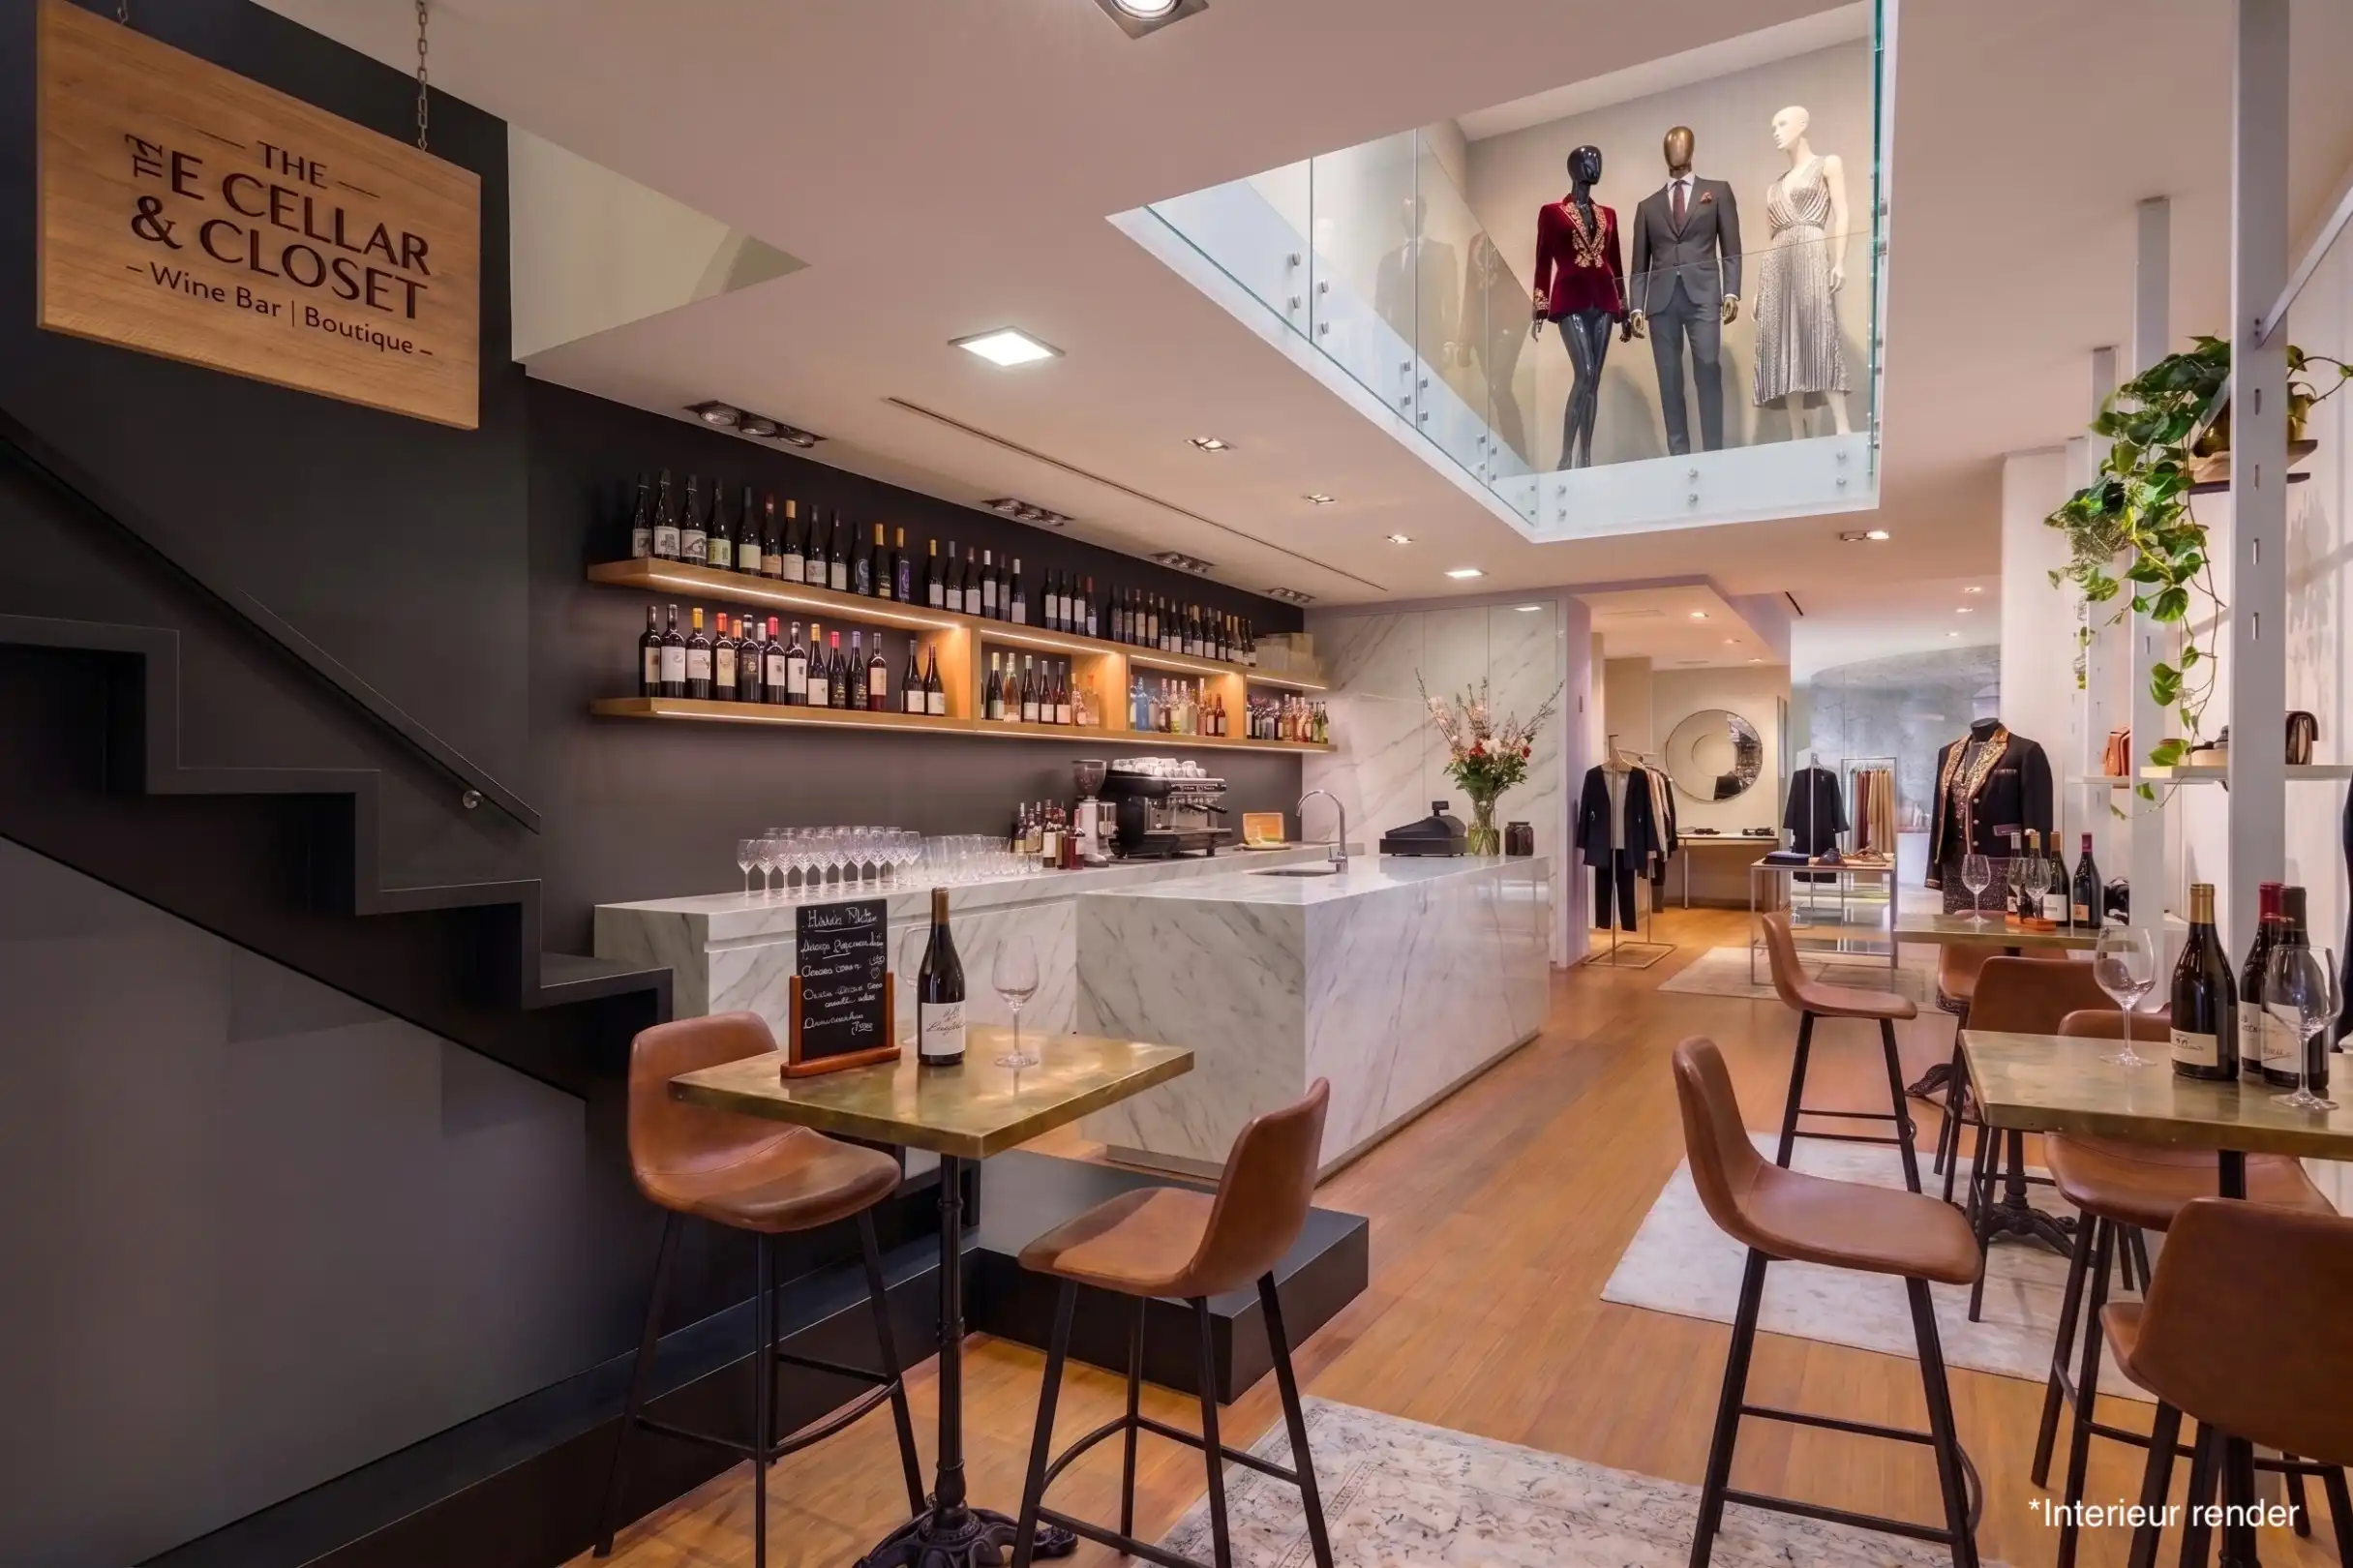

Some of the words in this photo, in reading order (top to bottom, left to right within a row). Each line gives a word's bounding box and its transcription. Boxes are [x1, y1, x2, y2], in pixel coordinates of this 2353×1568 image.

[256, 139, 328, 190] THE
[131, 195, 184, 250] &
[199, 219, 429, 319] CLOSET
[222, 172, 432, 276] CELLAR
[150, 261, 226, 303] Wine
[236, 286, 282, 317] Bar
[305, 306, 414, 352] Boutique
